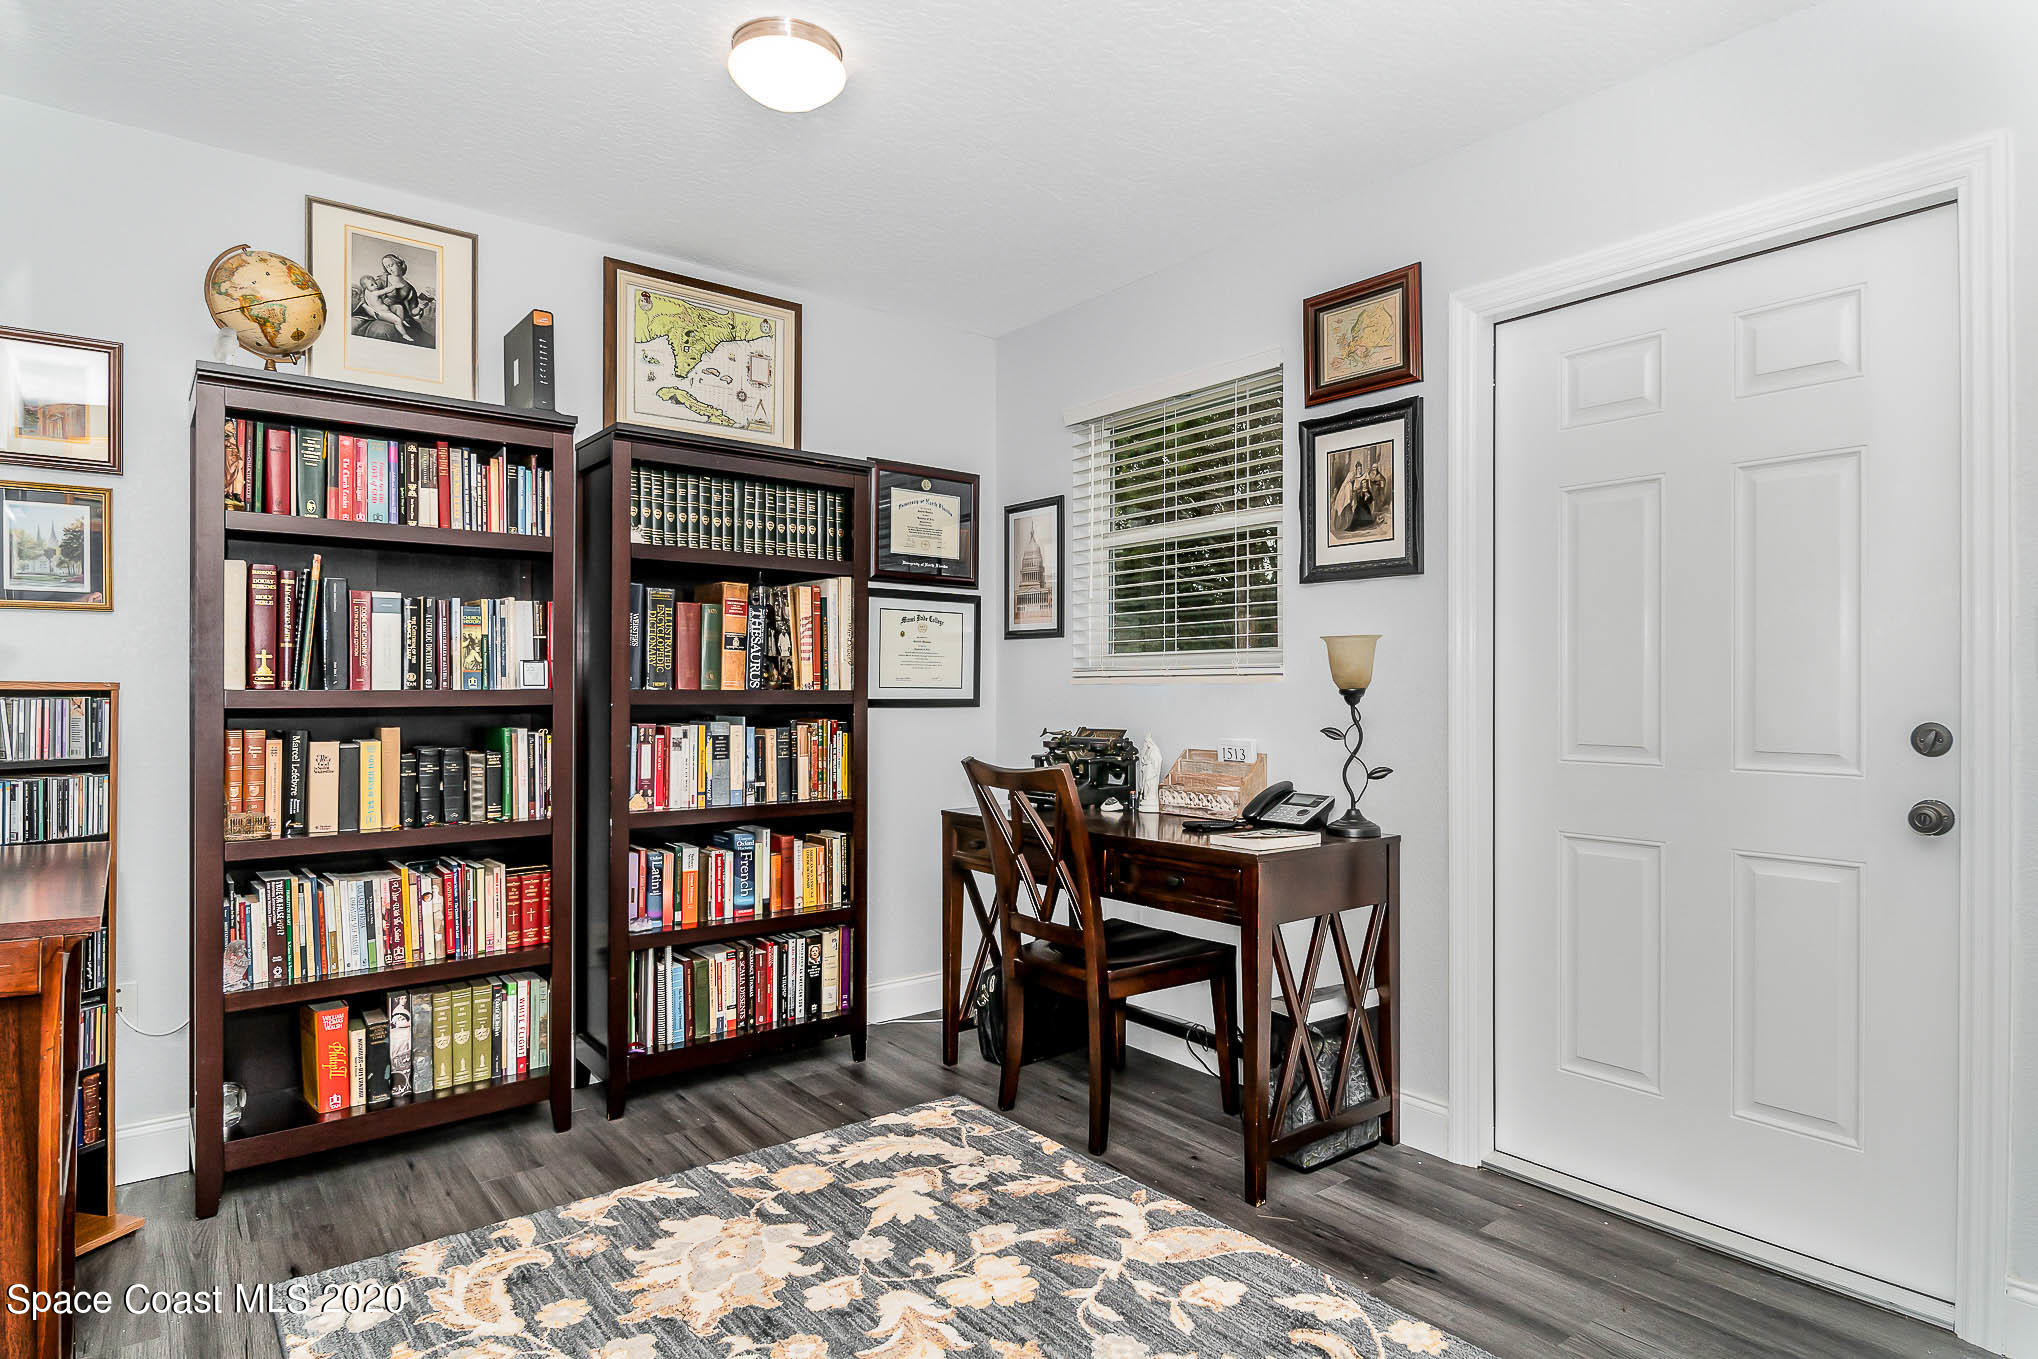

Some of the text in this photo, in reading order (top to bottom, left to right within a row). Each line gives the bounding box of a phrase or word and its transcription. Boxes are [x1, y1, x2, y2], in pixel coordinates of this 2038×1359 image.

[929, 616, 944, 626] College
[750, 608, 762, 688] THESAURUS
[291, 735, 300, 761] Marcel
[1222, 748, 1246, 760] 1513
[290, 764, 300, 796] Lefebvre
[652, 861, 662, 889] Latin
[740, 851, 752, 896] French
[322, 1013, 344, 1022] WILLIAM
[323, 1017, 344, 1027] THOMAS
[324, 1023, 343, 1031] WALSH
[322, 1042, 346, 1069] Philip
